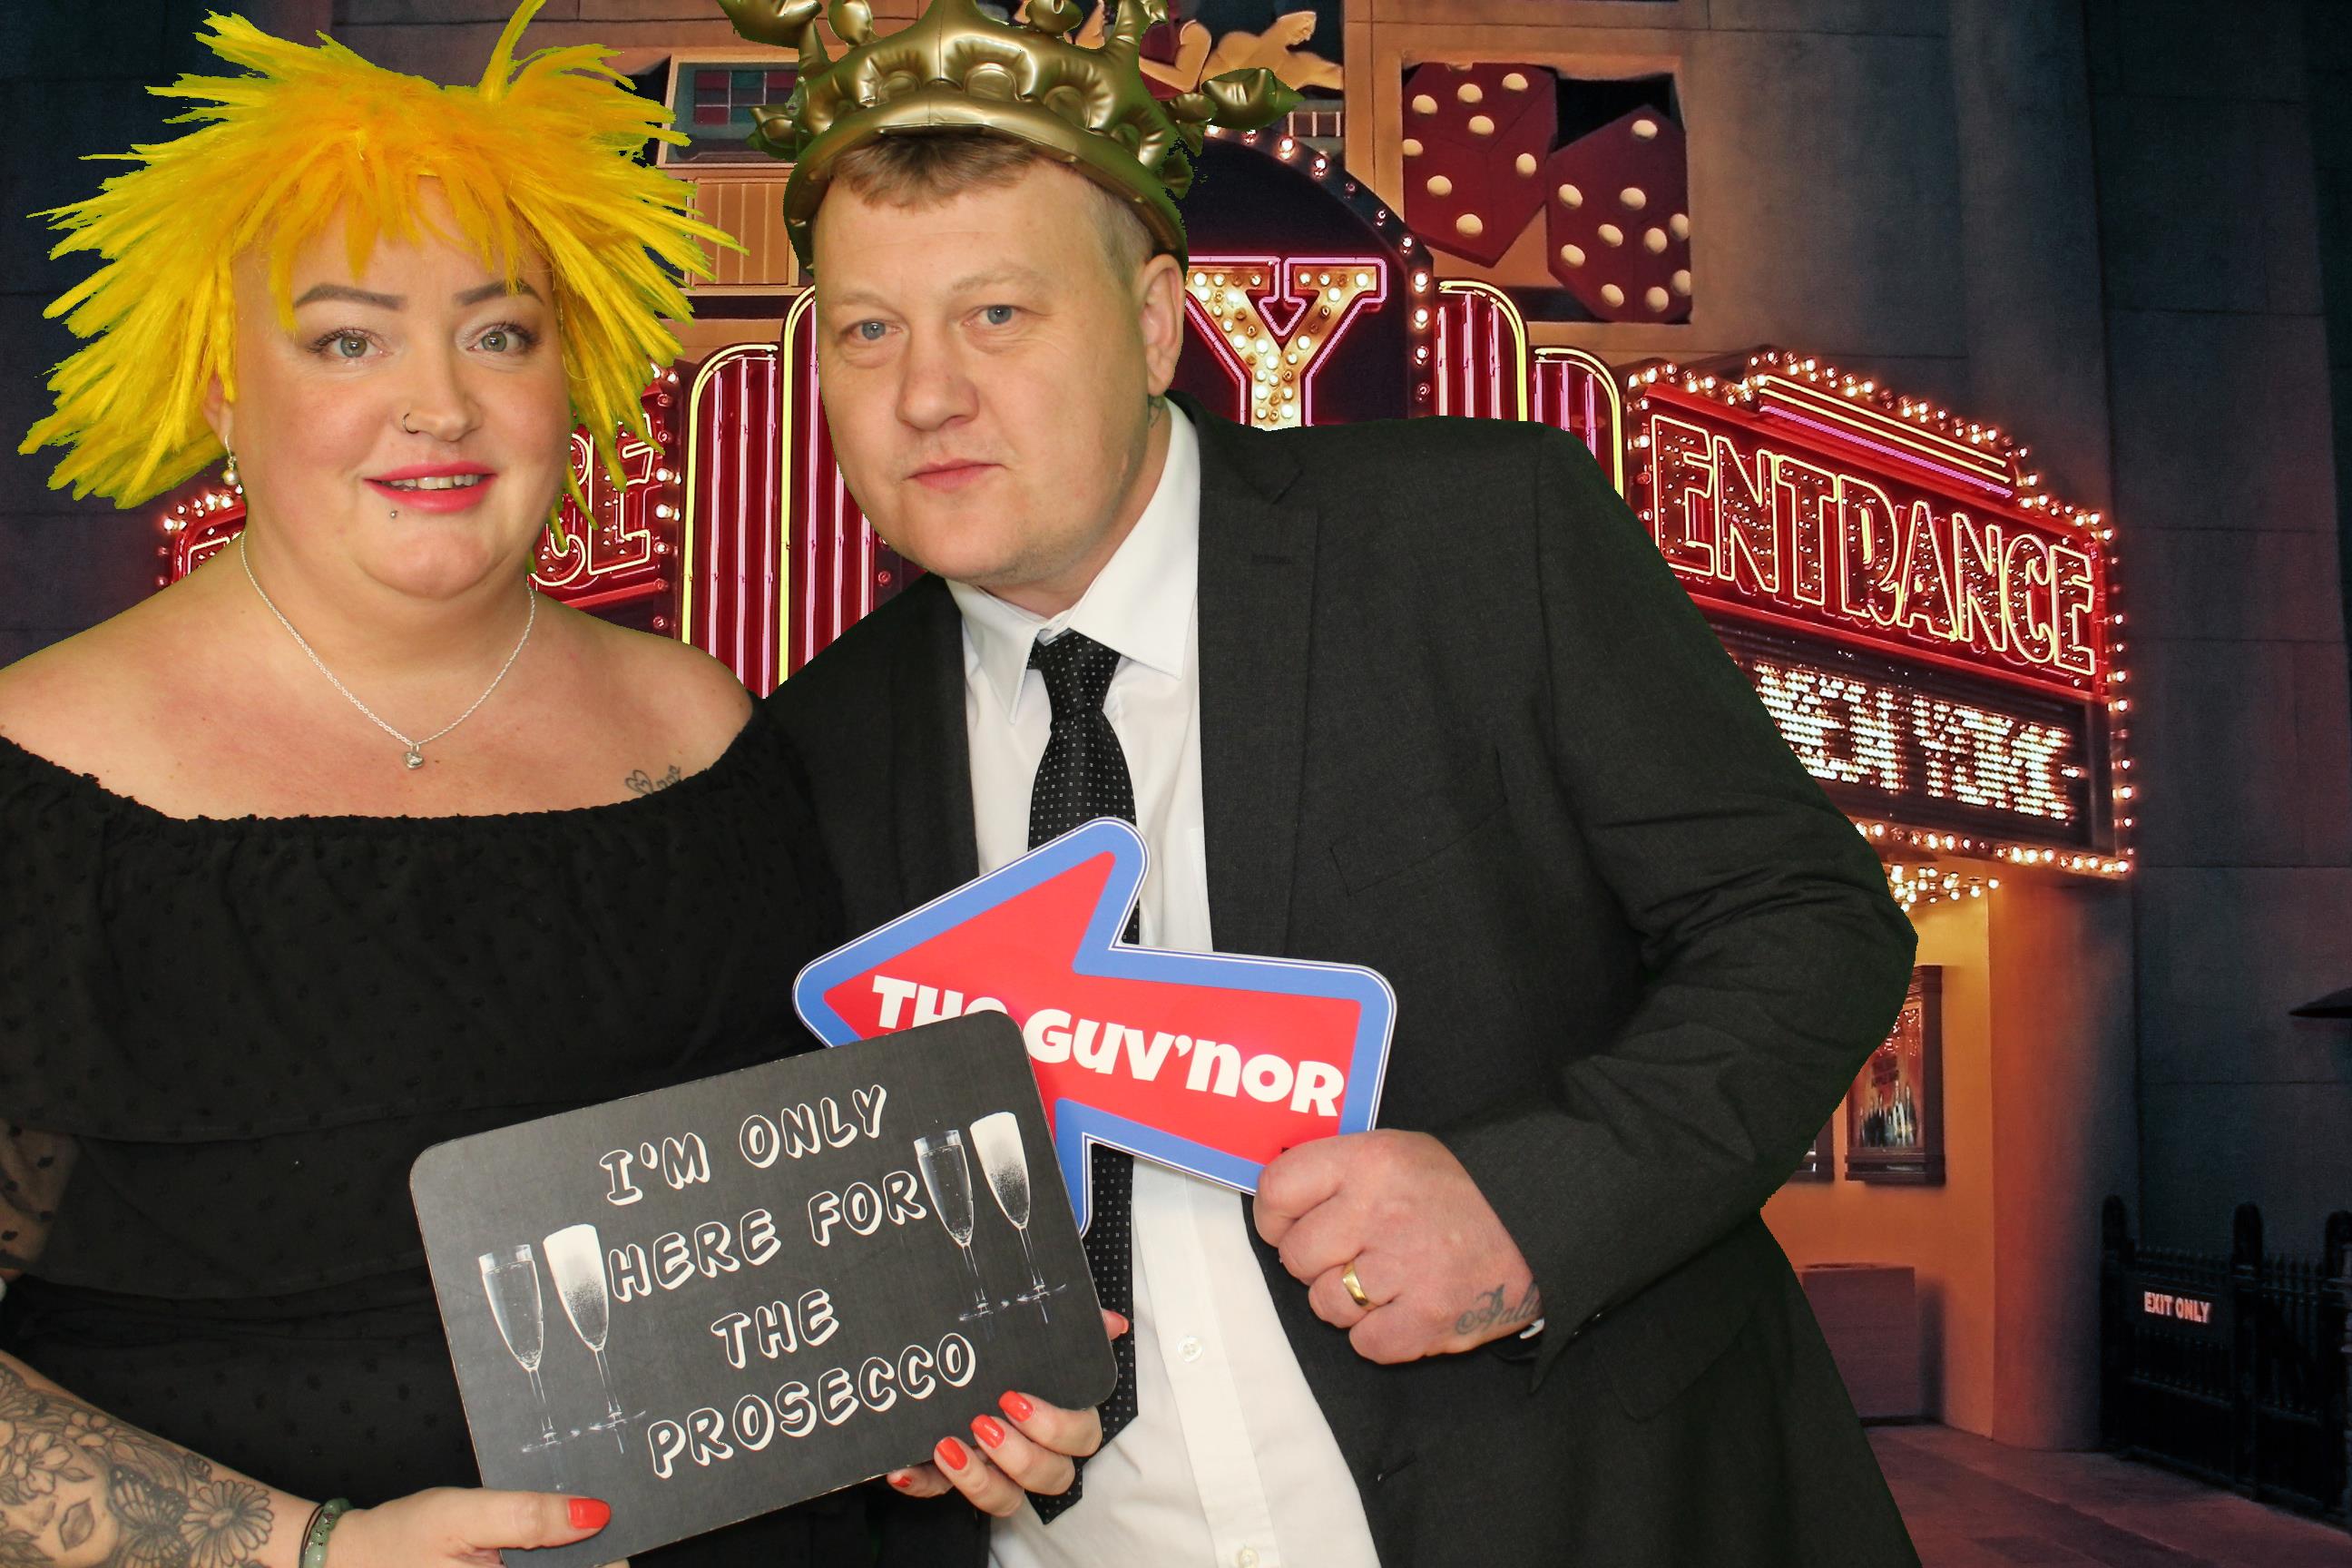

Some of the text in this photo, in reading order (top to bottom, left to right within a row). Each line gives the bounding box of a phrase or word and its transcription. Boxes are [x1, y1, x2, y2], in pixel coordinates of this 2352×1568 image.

[1651, 414, 2096, 675] ENTRANCE
[599, 1084, 887, 1206] I'M ONLY
[608, 1171, 926, 1302] HERE FOR
[710, 1289, 839, 1369] THE
[2143, 1290, 2211, 1323] EXIT ONLY
[648, 1332, 976, 1479] PROSECCO
